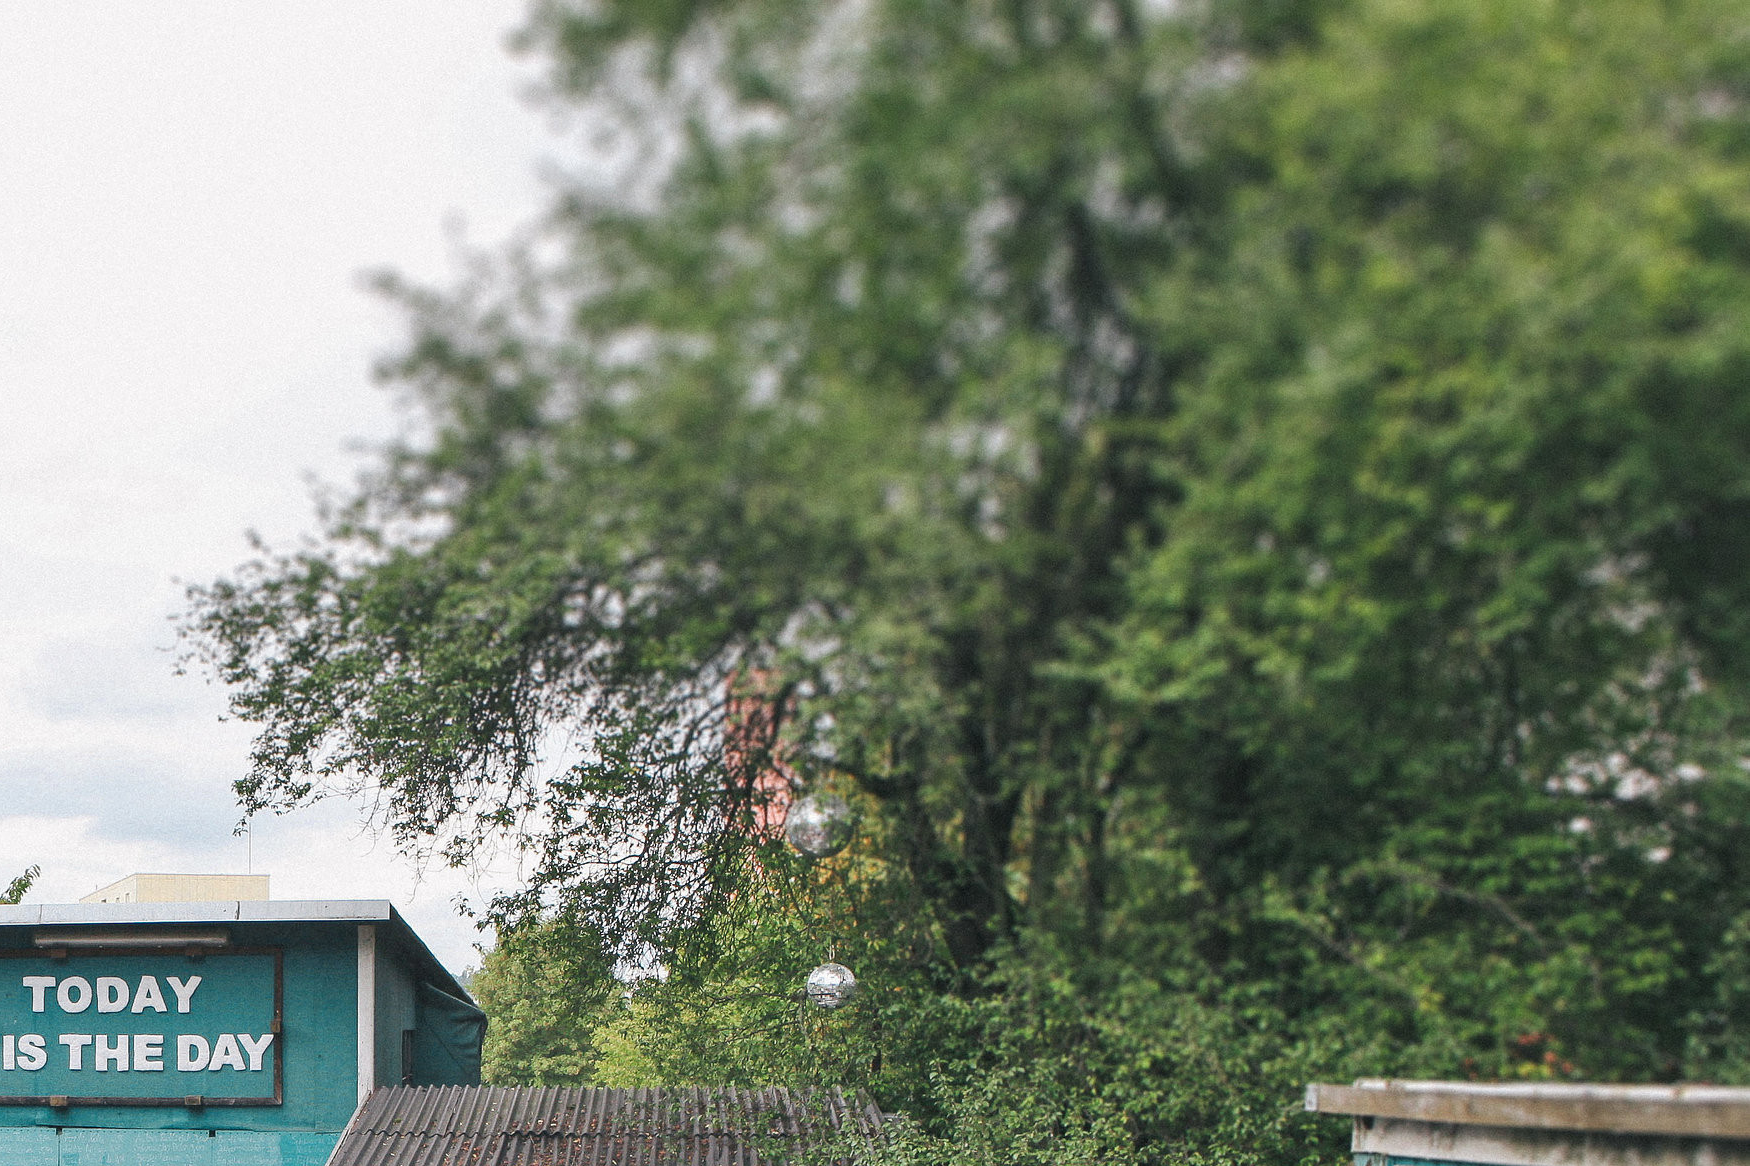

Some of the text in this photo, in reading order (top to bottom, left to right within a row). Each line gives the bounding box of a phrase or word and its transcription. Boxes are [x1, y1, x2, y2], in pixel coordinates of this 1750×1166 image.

[22, 975, 202, 1013] TODAY
[2, 1033, 274, 1072] IS THE DAY
